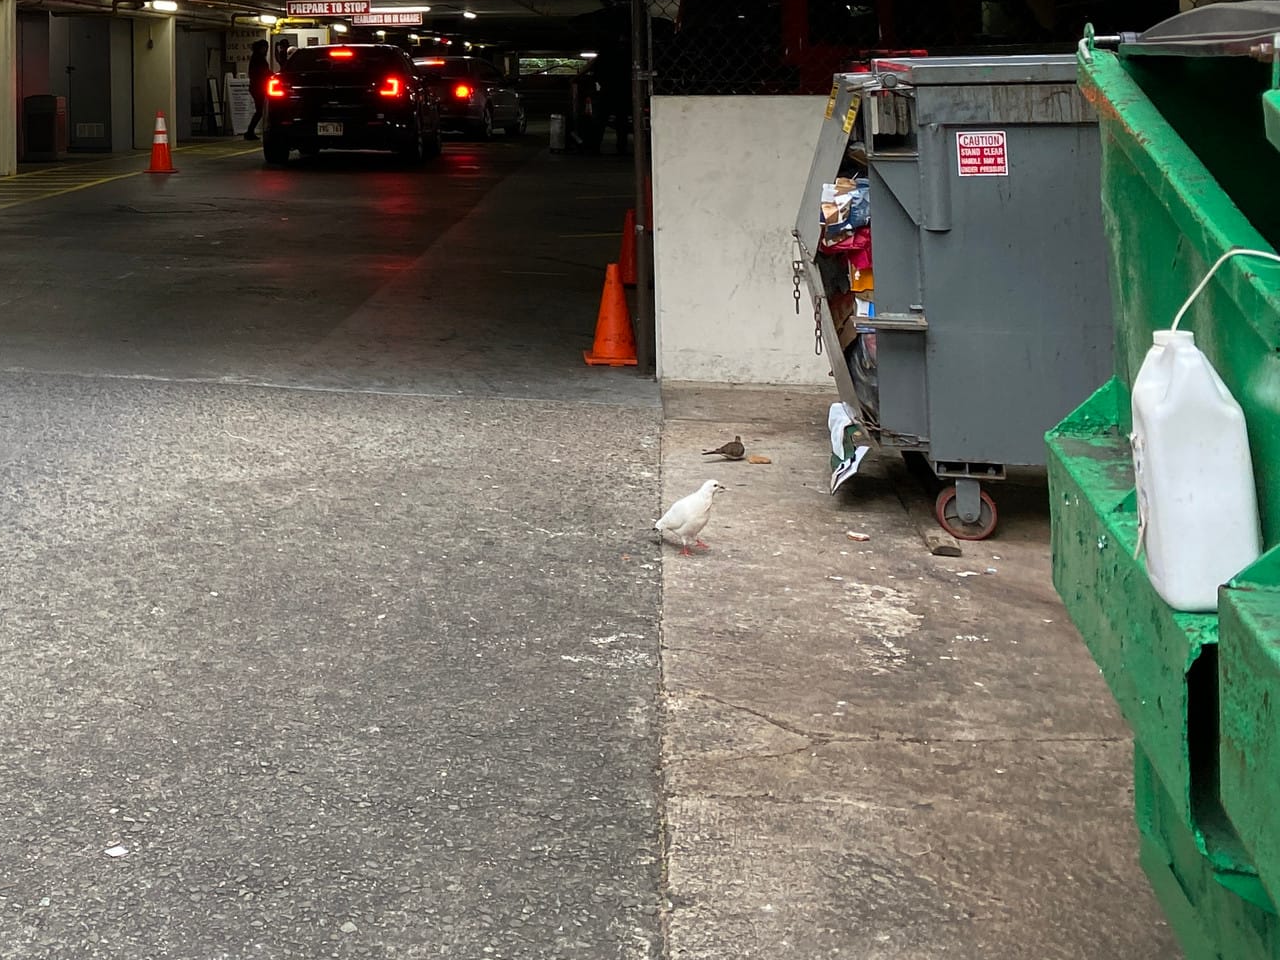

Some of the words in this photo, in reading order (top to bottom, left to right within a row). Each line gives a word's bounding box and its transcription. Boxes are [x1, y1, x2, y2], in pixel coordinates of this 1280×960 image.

[290, 2, 329, 14] PREPARE
[330, 2, 344, 13] TO
[344, 2, 368, 13] STOP
[963, 135, 1000, 146] CAUTION
[961, 147, 981, 156] STAND
[983, 147, 1003, 156] CLEAR
